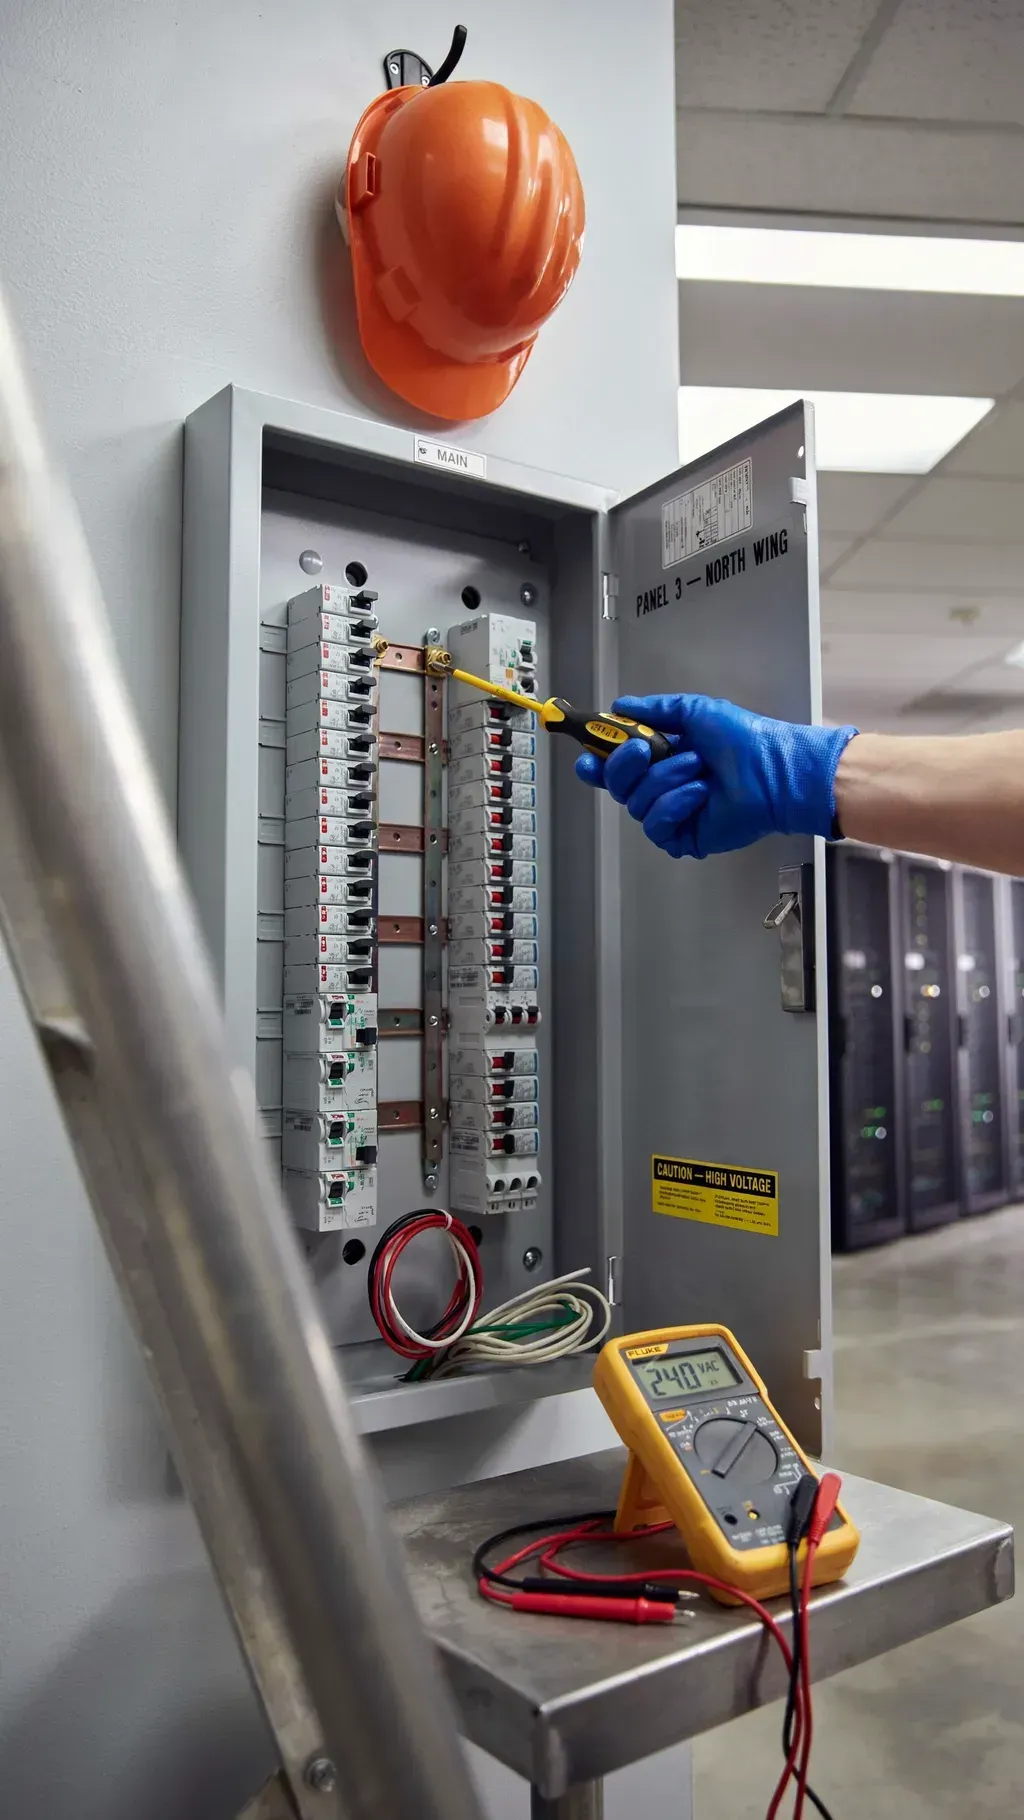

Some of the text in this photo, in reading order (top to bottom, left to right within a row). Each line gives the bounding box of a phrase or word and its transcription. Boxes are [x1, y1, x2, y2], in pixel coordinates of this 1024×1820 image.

[437, 449, 468, 468] MAIN
[636, 584, 669, 618] PANEL
[675, 577, 682, 600] 3
[706, 547, 746, 587] NORTH
[753, 529, 788, 566] WING
[657, 1162, 693, 1180] CAUTION
[705, 1170, 727, 1187] HIGH
[729, 1174, 772, 1194] VOLTAGE
[628, 1346, 662, 1357] FLUKE
[646, 1360, 720, 1396] 240 VAC
